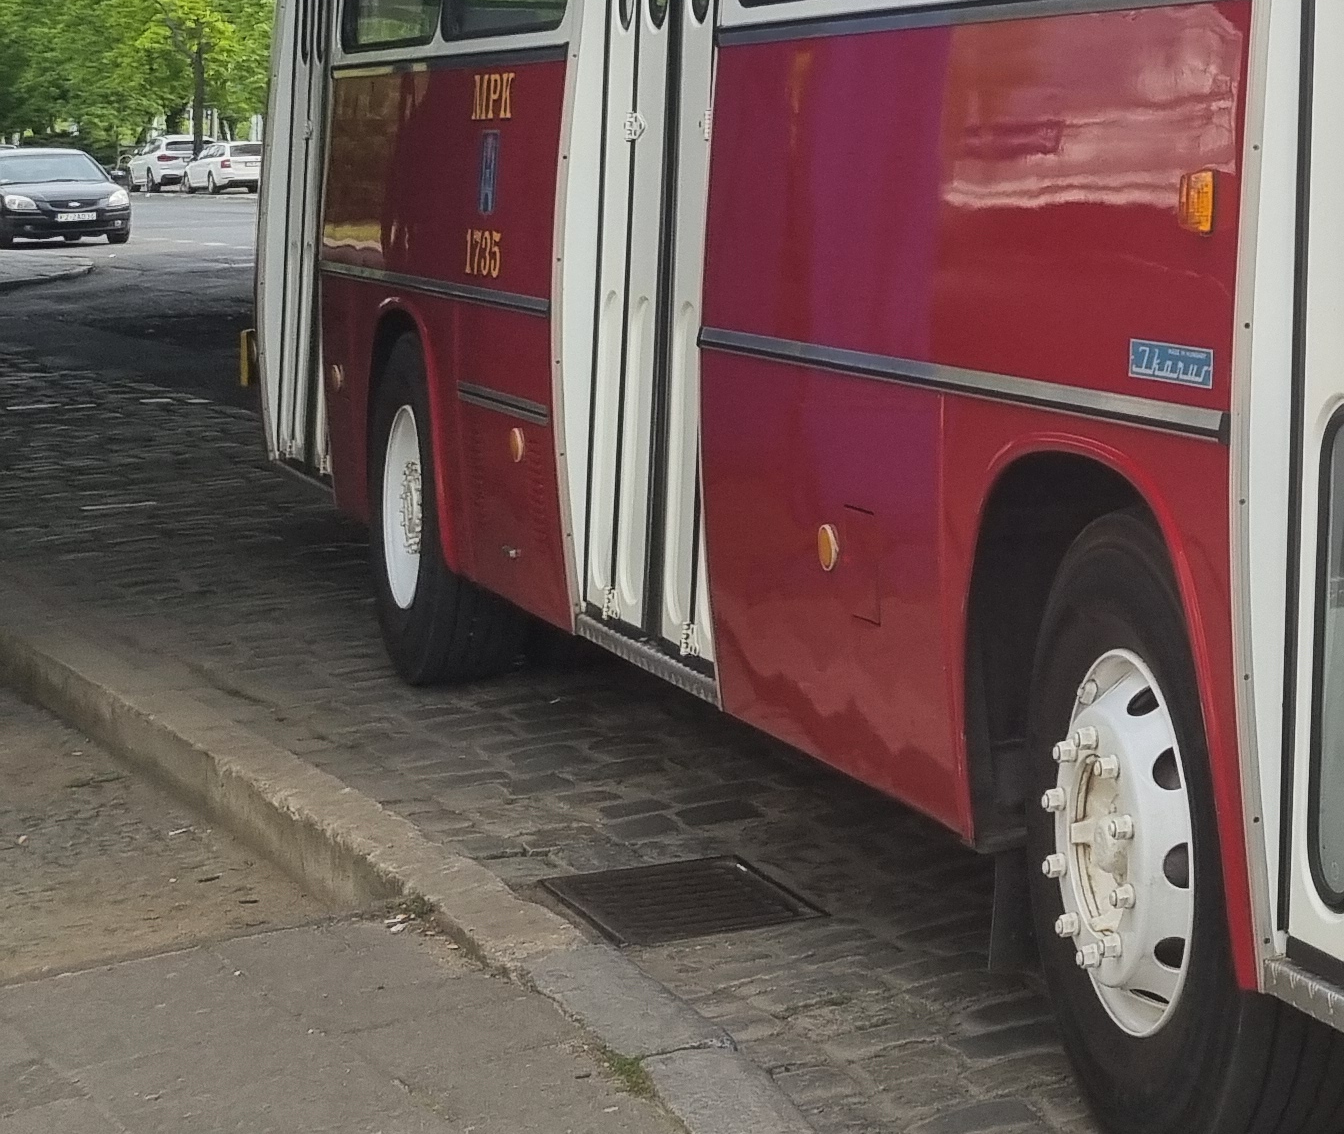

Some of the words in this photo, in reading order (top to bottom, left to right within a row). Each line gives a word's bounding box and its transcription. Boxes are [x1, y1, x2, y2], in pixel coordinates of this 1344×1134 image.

[471, 72, 515, 121] MPK
[464, 227, 502, 278] 1735
[1132, 346, 1210, 382] Ikarus
